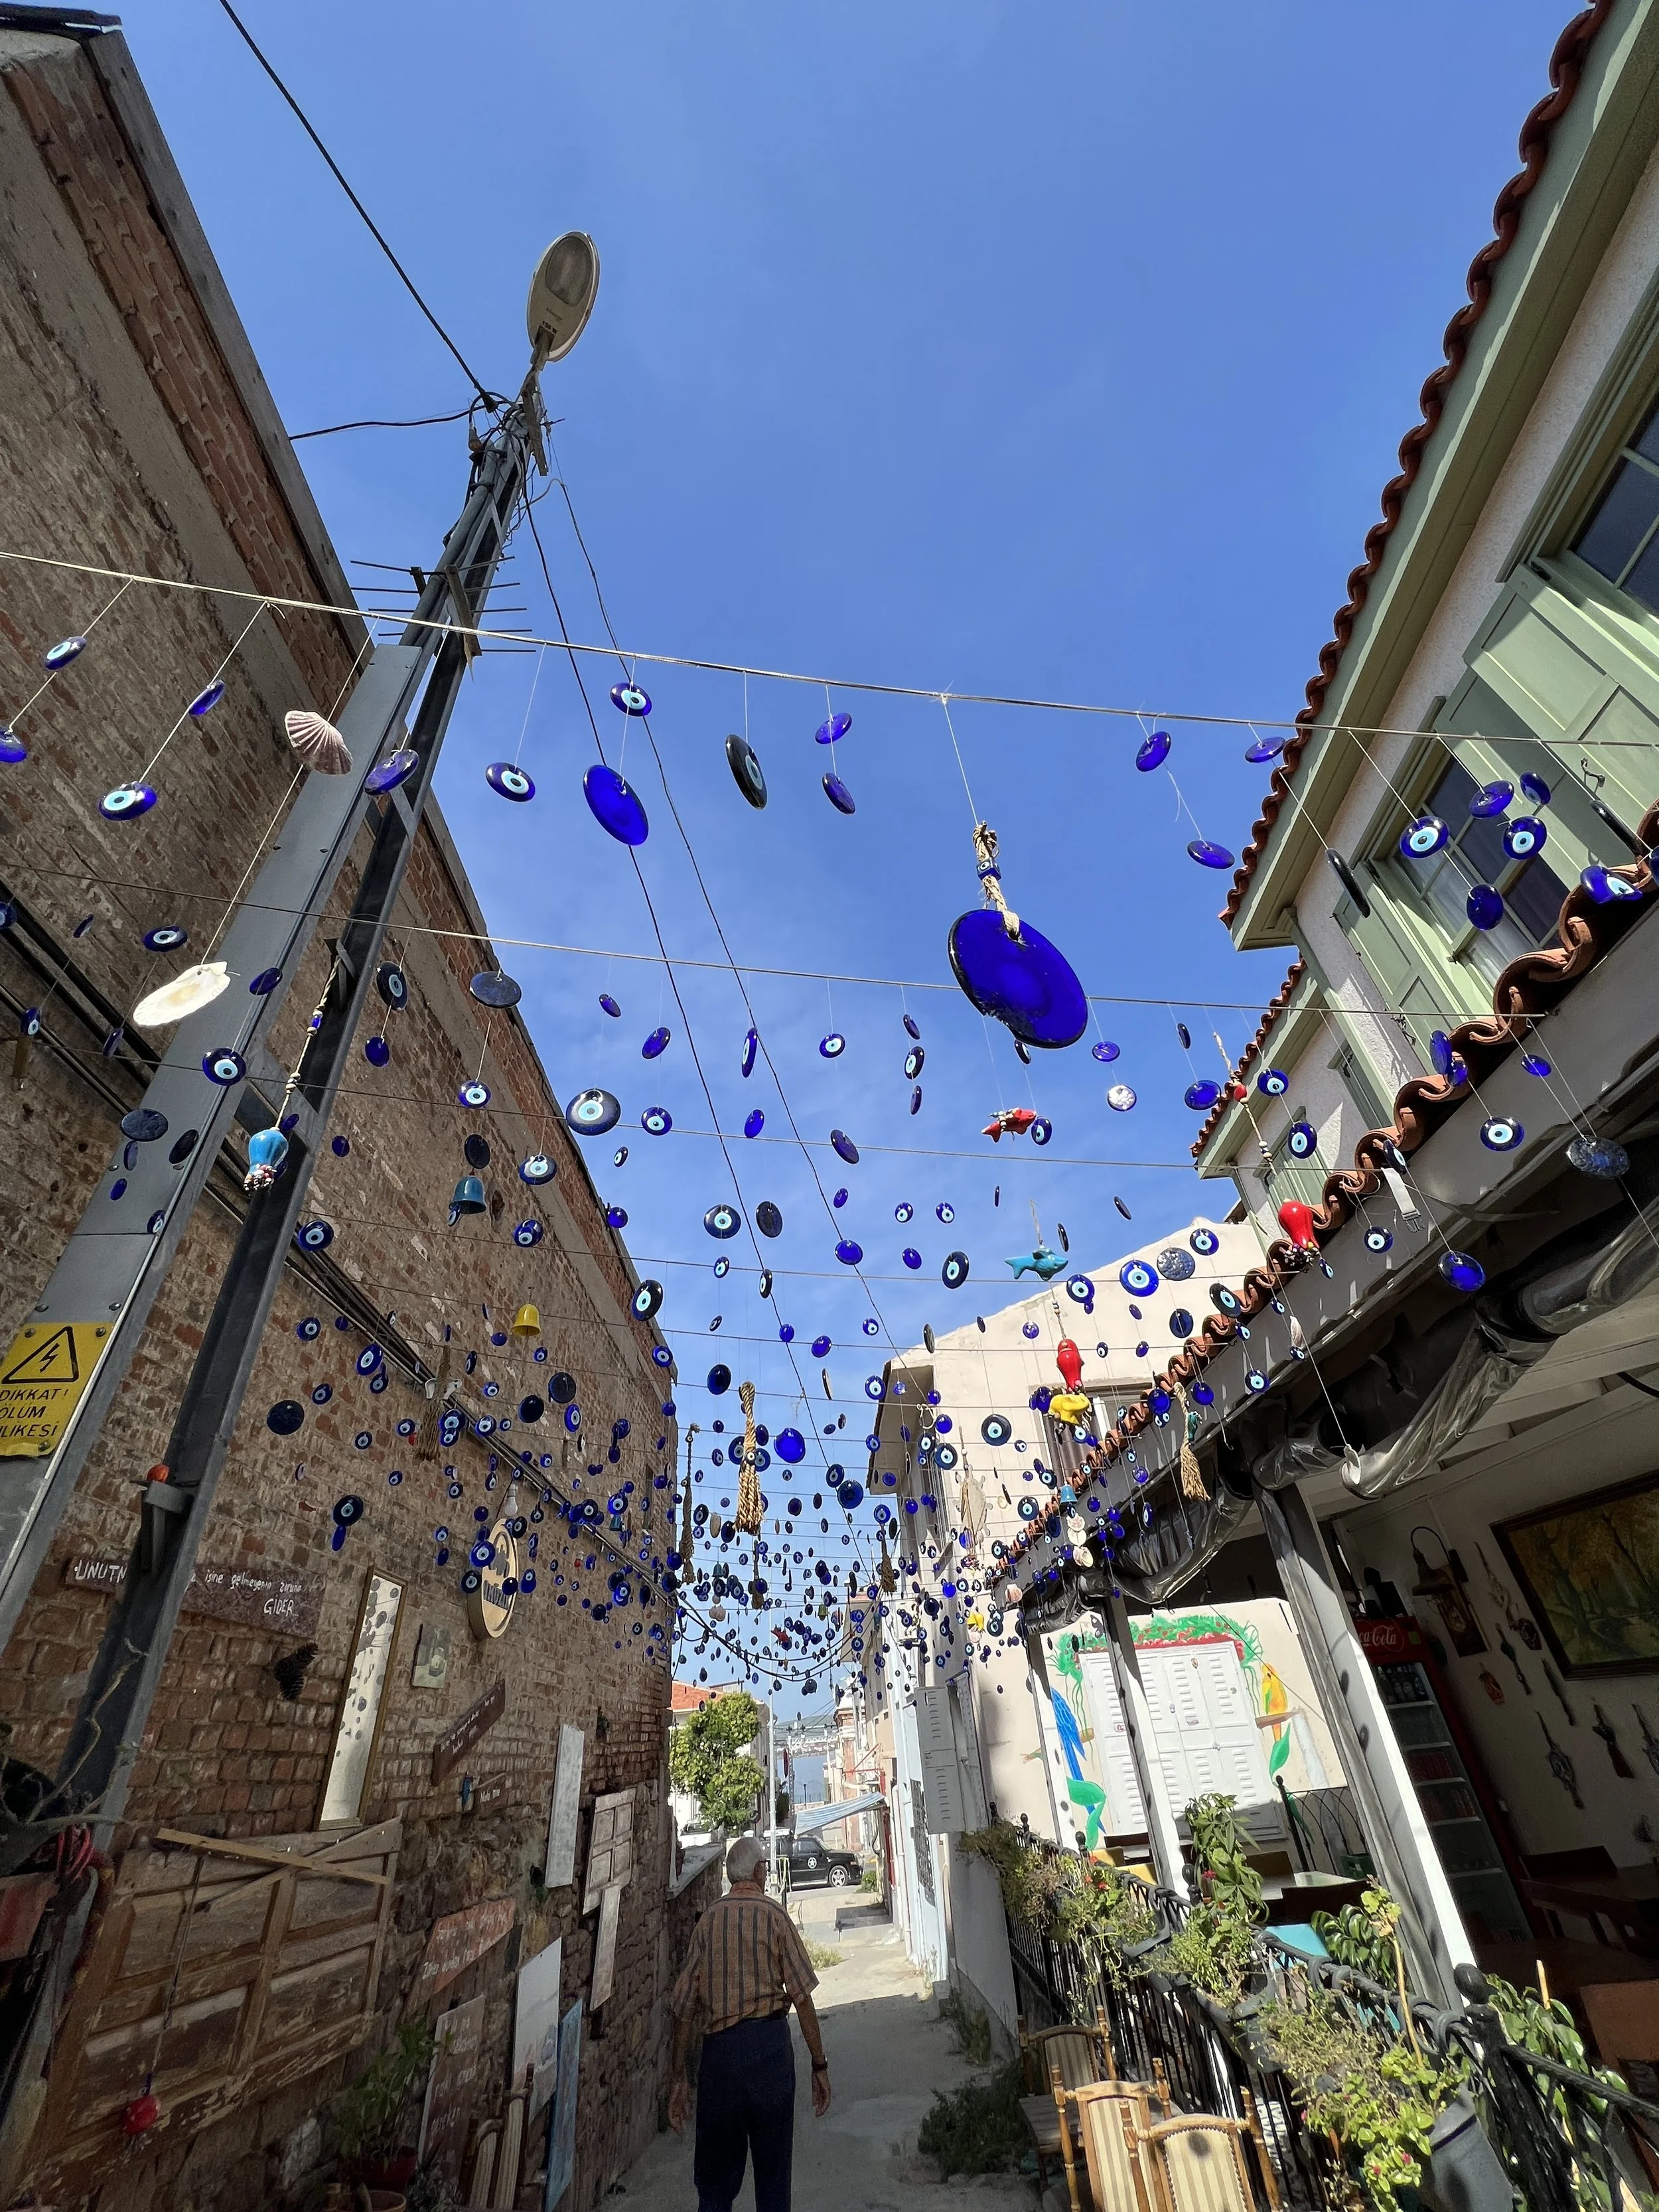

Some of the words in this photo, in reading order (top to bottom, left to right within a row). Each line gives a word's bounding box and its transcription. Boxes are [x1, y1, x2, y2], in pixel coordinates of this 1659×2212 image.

[0, 1402, 47, 1419] ÖLÜM
[0, 1421, 59, 1438] LİKESİ
[1359, 1625, 1397, 1647] ca-Cola
